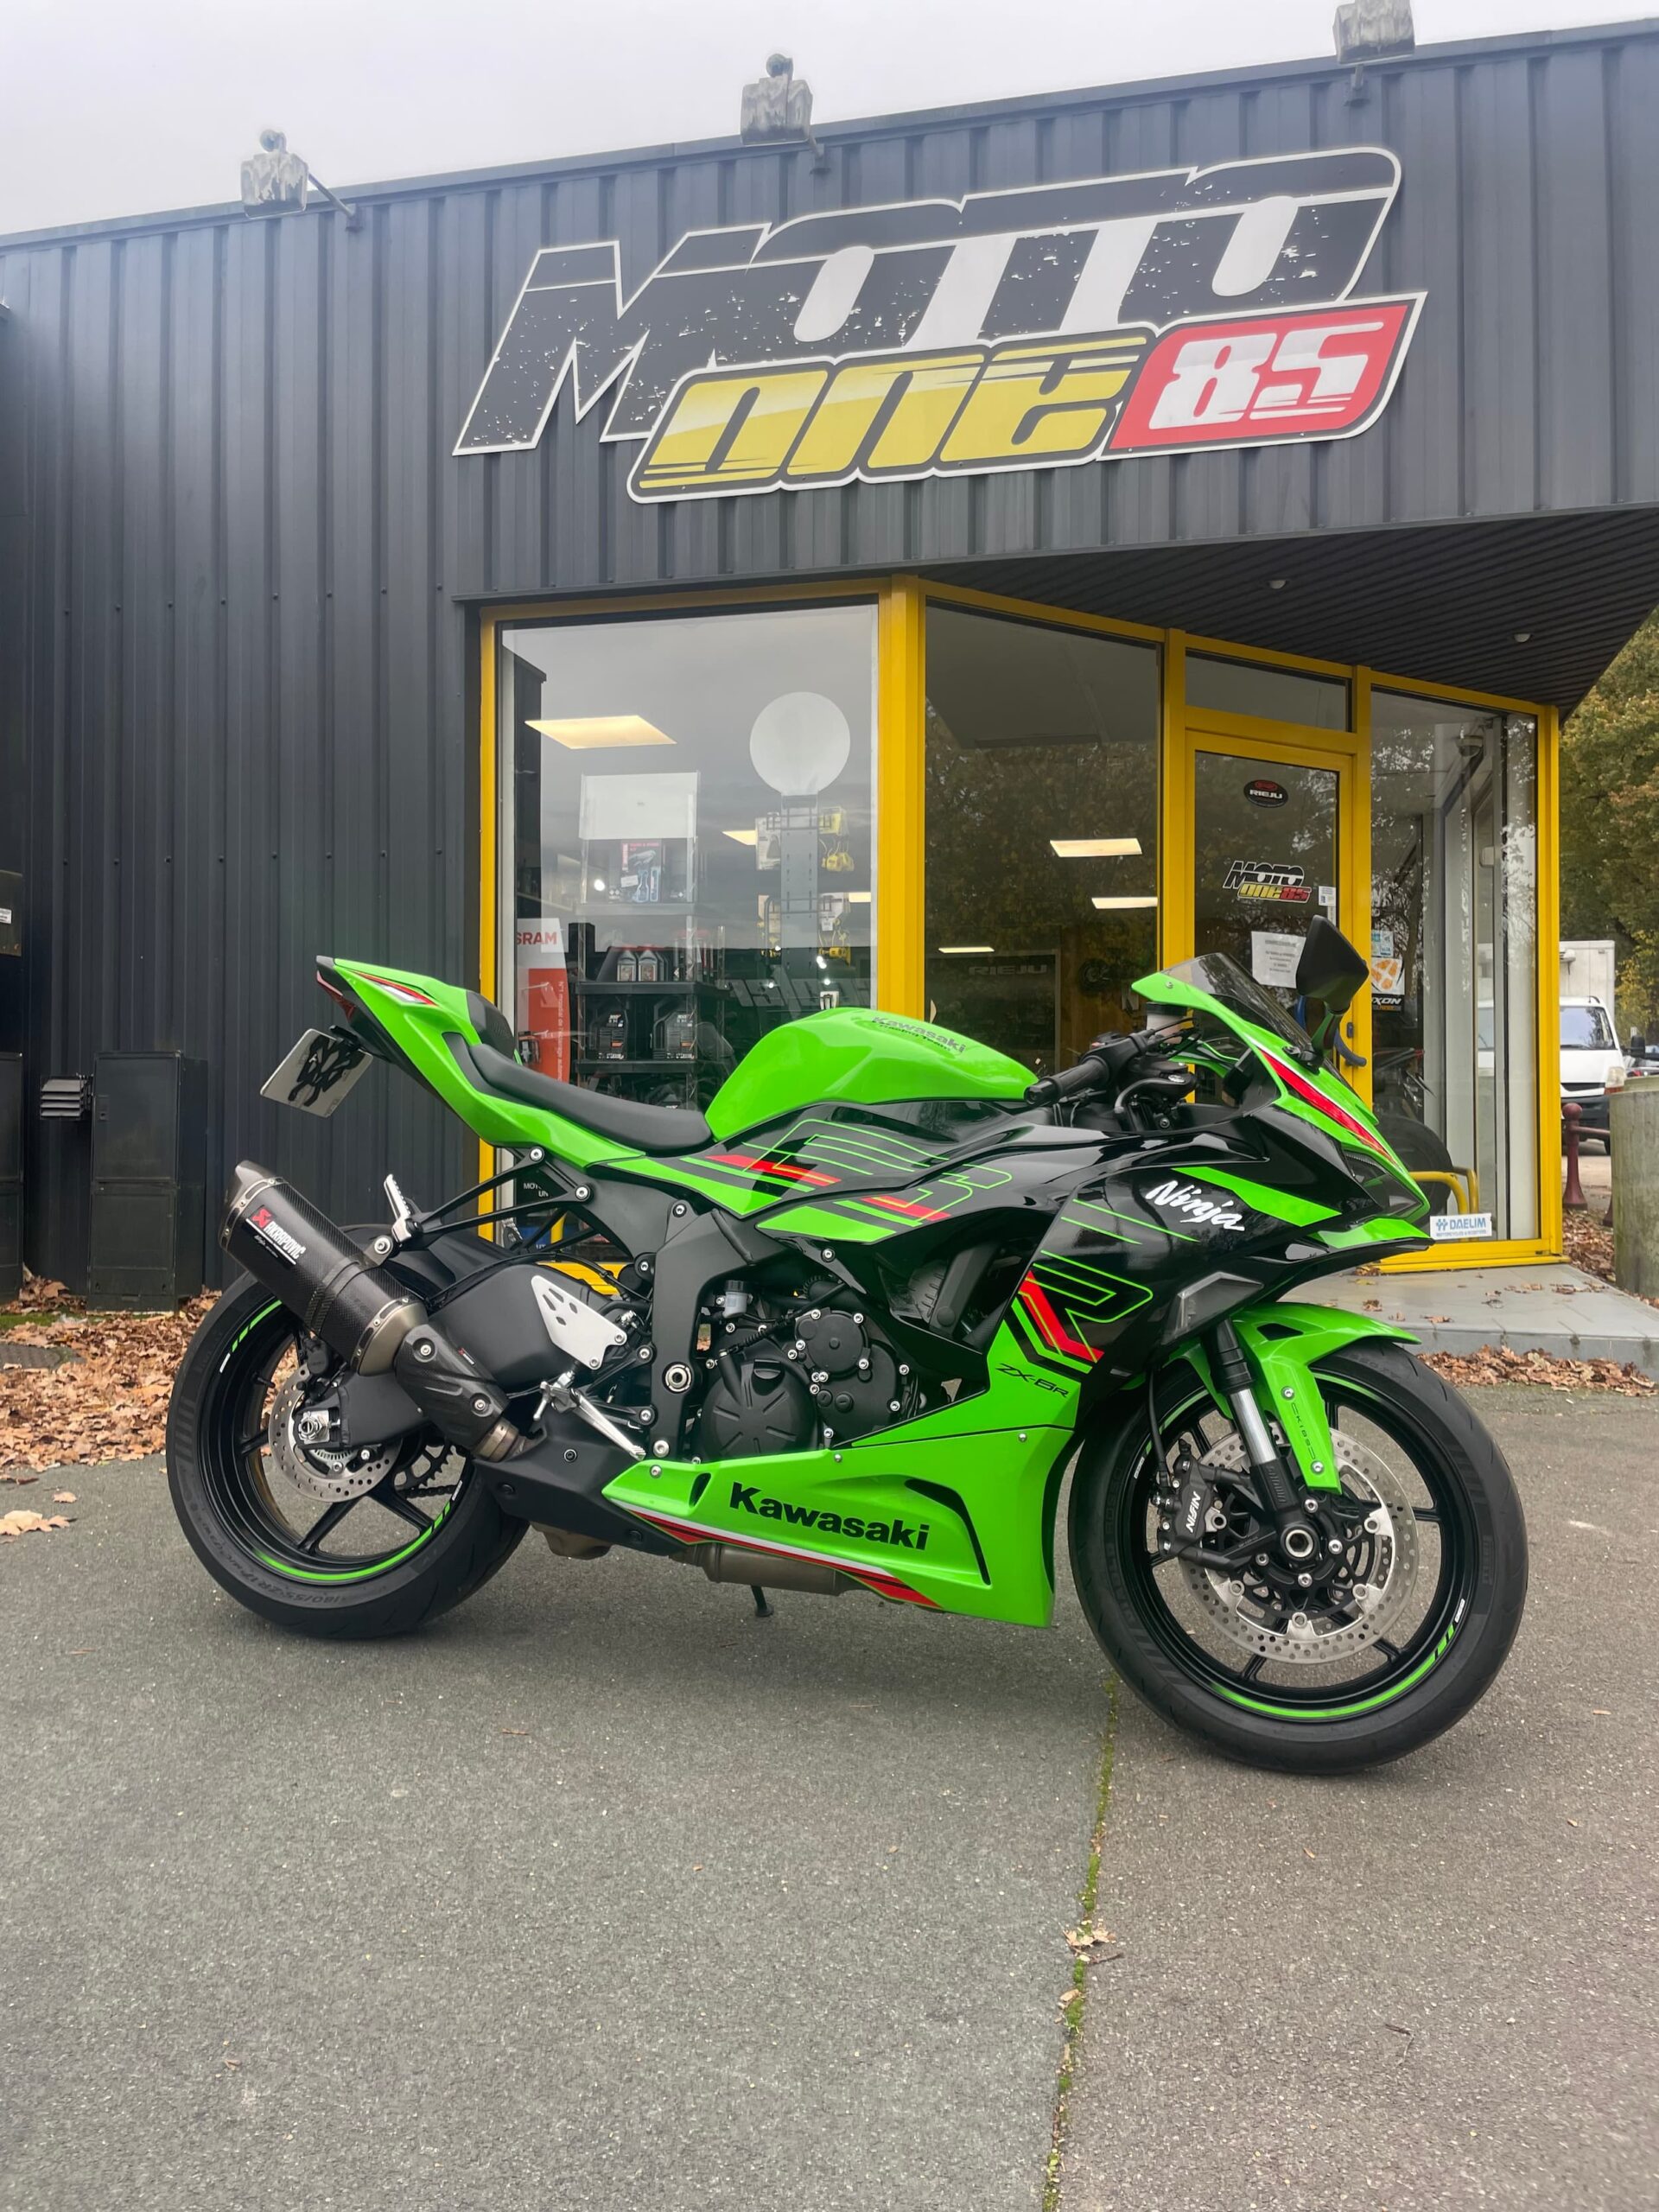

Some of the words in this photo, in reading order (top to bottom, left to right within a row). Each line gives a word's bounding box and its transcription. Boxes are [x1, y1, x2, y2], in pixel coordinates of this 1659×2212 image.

[1147, 320, 1385, 430] 85
[1249, 789, 1283, 799] RIEJU
[1223, 861, 1305, 889] MOTO
[968, 964, 1048, 976] RIEJU
[1371, 996, 1402, 1006] XON
[872, 1017, 966, 1053] Kawasaki
[1145, 1180, 1245, 1231] Ninja
[1449, 1217, 1486, 1230] DAELIM
[995, 1363, 1069, 1398] ZX-6R
[729, 1481, 930, 1551] Kawasaki
